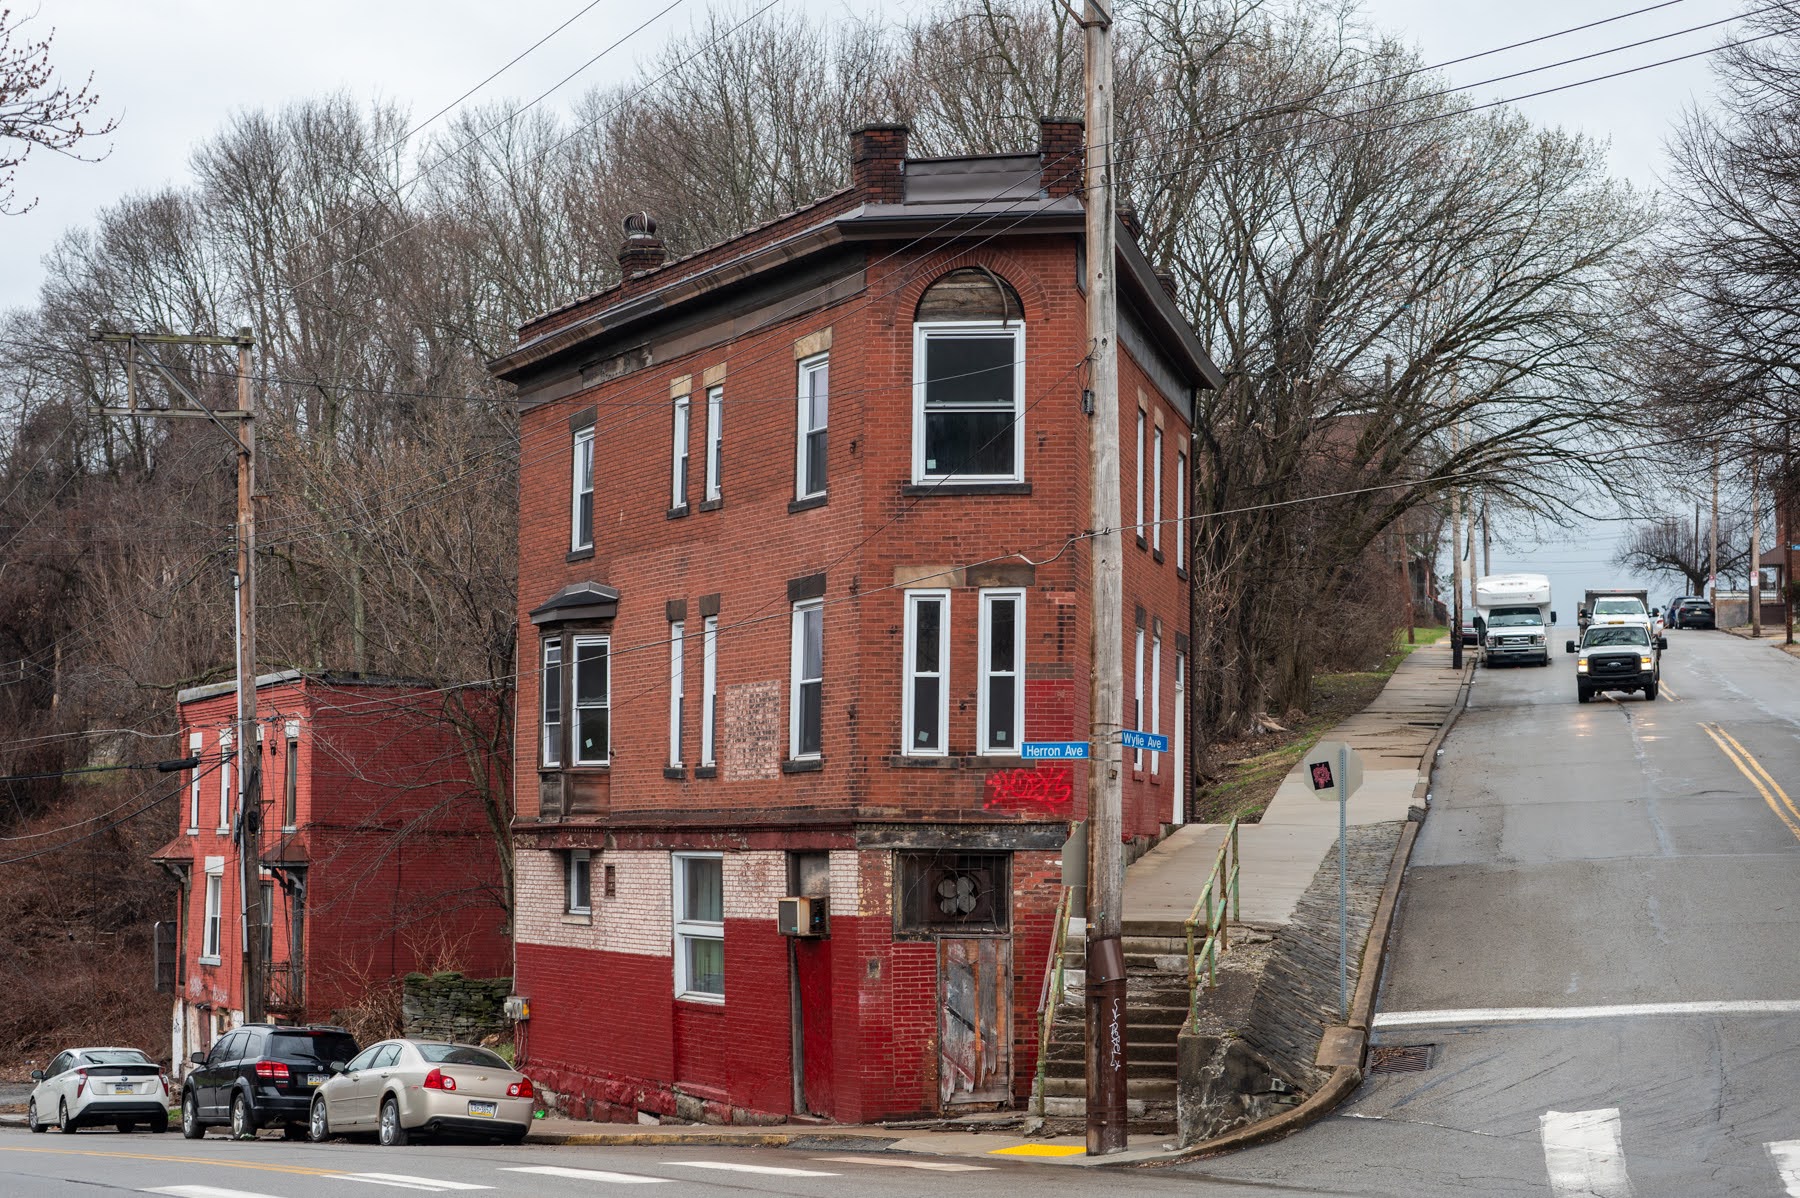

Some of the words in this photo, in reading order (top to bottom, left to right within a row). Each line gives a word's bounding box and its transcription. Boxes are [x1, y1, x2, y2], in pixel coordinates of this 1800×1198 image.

[1123, 733, 1145, 747] Wylie
[1147, 736, 1162, 748] Ave
[1026, 745, 1061, 757] Herron
[1064, 745, 1083, 757] Ave
